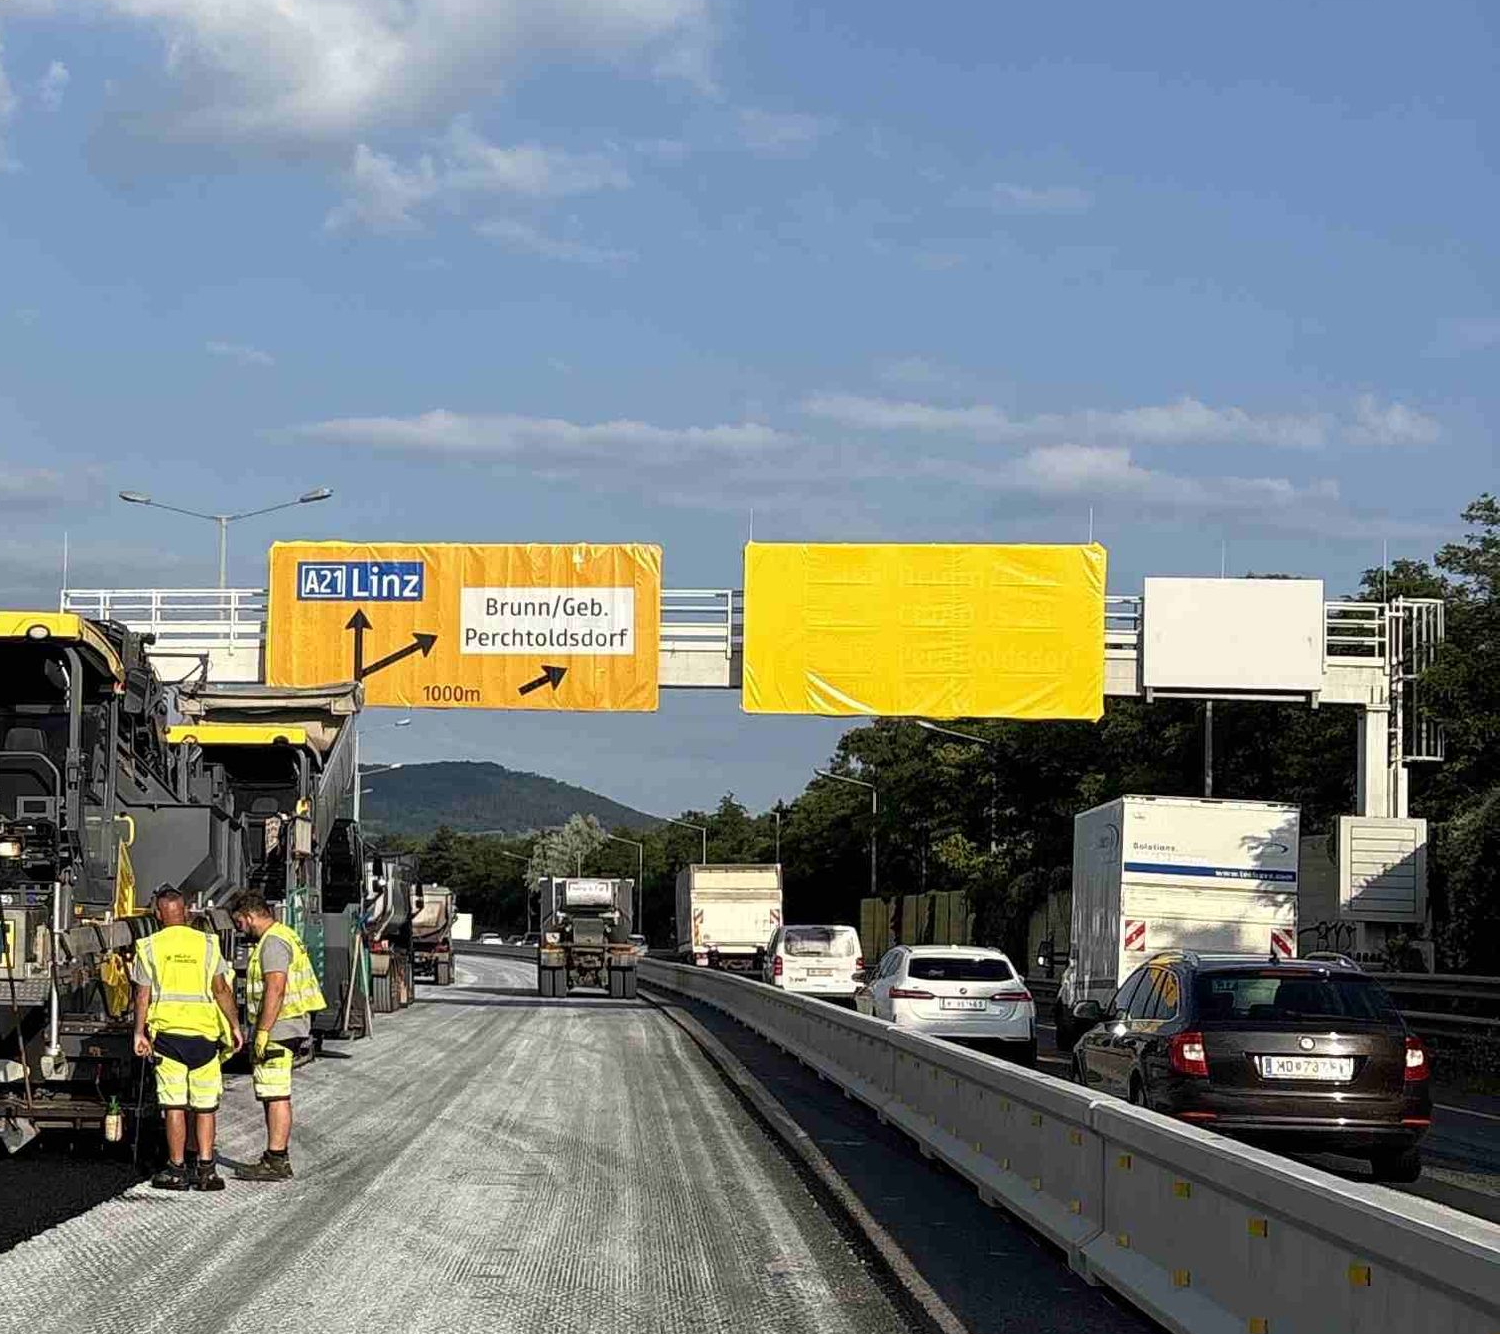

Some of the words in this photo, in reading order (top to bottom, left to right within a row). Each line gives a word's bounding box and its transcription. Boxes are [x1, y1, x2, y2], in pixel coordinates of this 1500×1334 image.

[306, 570, 342, 593] A21
[352, 567, 420, 597] Linz
[485, 597, 609, 618] Brunn/Geb.
[465, 627, 629, 649] Perchtoldsdorf
[423, 685, 481, 703] 1000m
